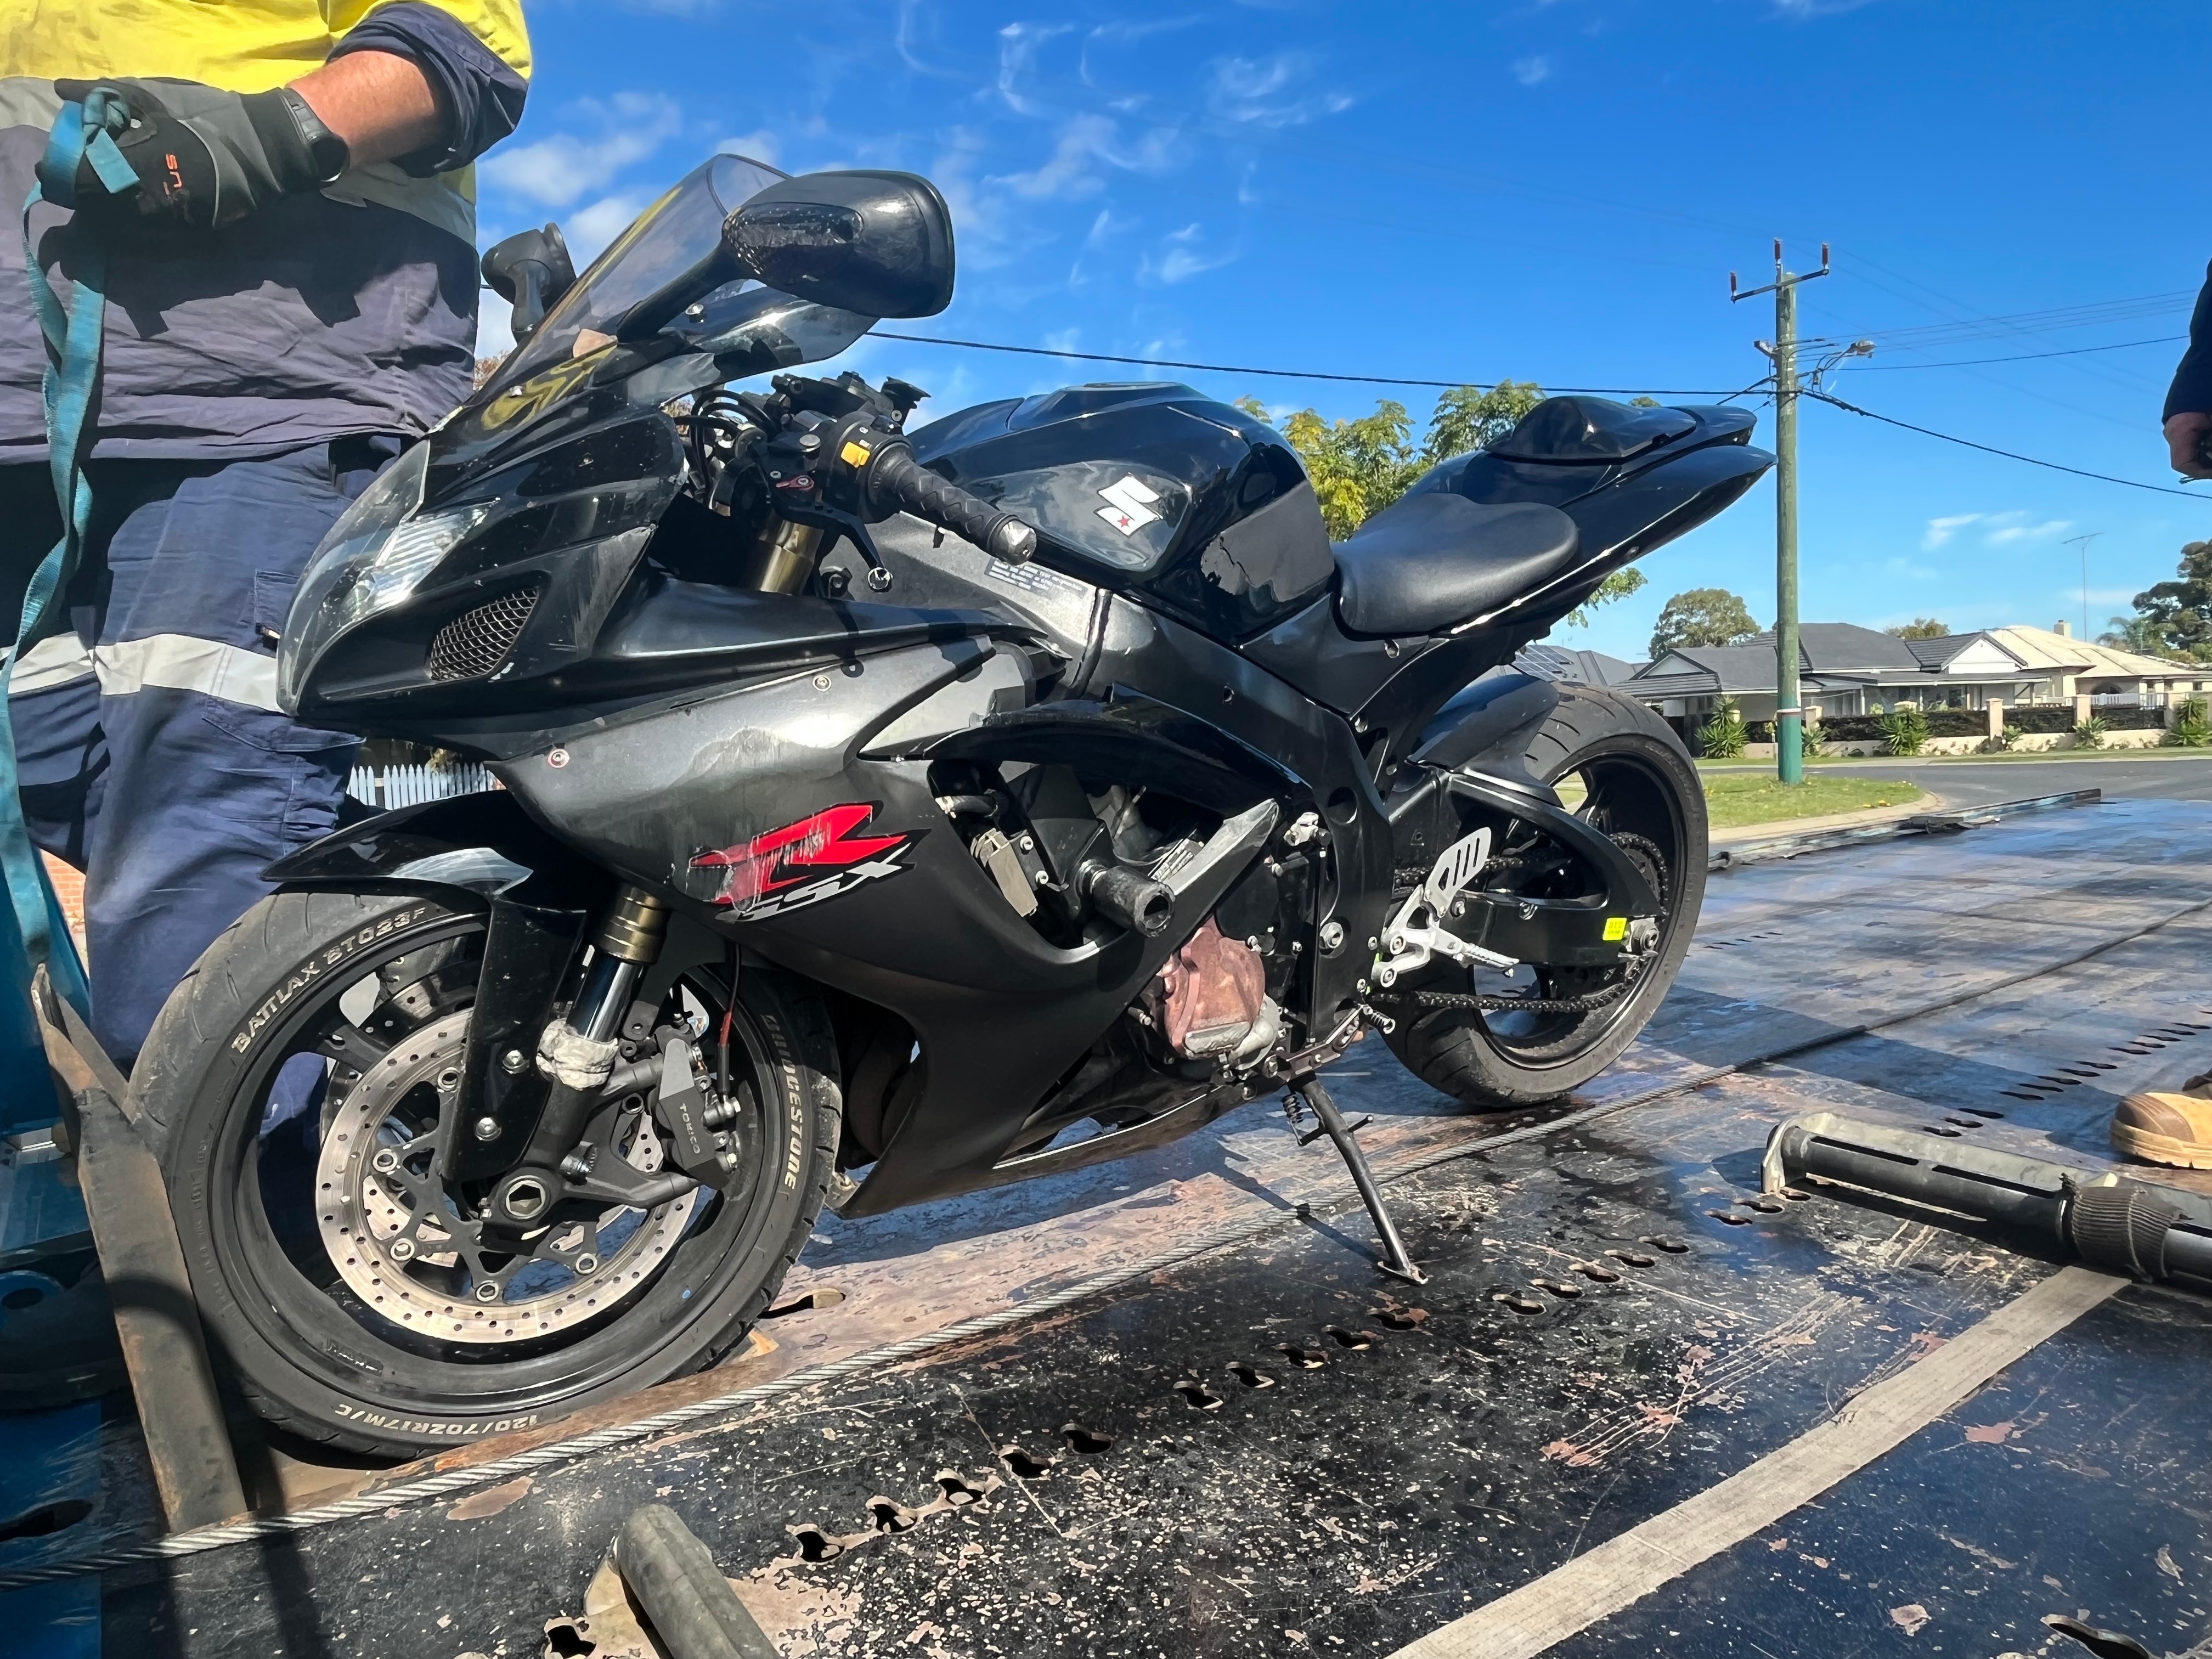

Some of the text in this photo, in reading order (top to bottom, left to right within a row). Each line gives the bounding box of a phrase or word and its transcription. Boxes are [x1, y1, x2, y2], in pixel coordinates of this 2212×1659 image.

[231, 961, 320, 1053] BATTLAX
[680, 1103, 701, 1154] TOKICO
[760, 1013, 803, 1190] BRIDGESTONE
